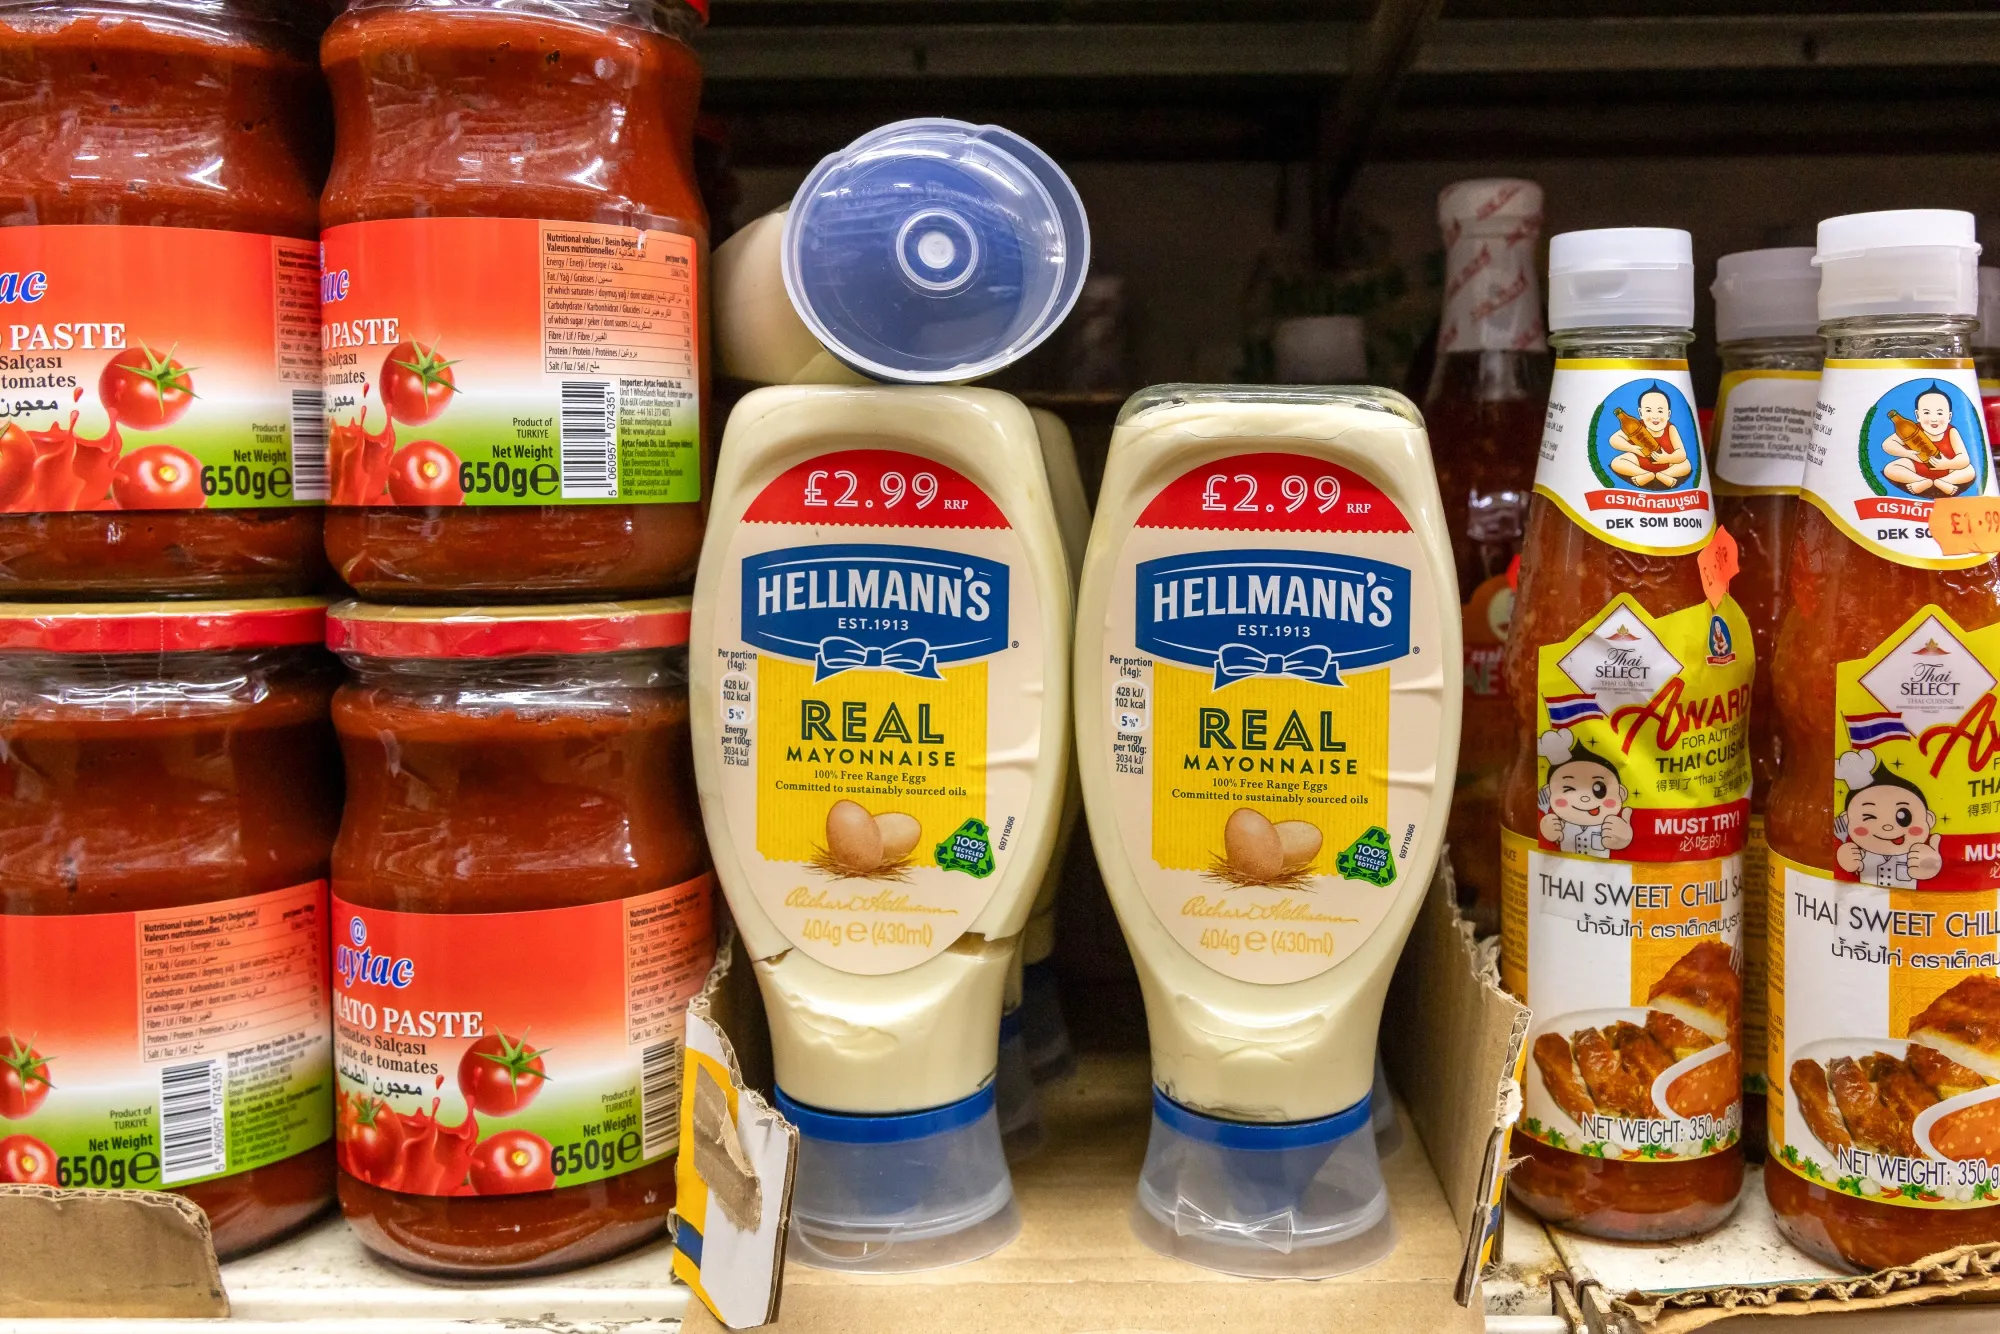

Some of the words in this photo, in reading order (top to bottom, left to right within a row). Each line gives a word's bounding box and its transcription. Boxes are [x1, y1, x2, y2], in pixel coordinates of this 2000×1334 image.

[547, 233, 580, 243] Nutritional
[582, 236, 600, 245] values
[547, 243, 570, 252] Valeurs
[571, 246, 614, 256] nutritionnelles
[546, 258, 564, 268] Energy
[574, 274, 594, 283] Graisses
[548, 301, 582, 312] Carbohydrate
[10, 323, 127, 350] PASTE
[332, 318, 400, 349] PASTE
[548, 331, 561, 340] Fibre
[578, 332, 590, 341] Fibre
[548, 346, 568, 355] Protein
[573, 346, 590, 356] Protein
[0, 355, 62, 372] Salçası
[549, 361, 560, 370] Salt
[2, 373, 76, 389] tomates
[329, 370, 366, 384] tomates
[607, 392, 616, 430] 074351
[252, 424, 278, 432] Product
[279, 424, 286, 432] of
[512, 418, 542, 427] Product
[544, 418, 552, 427] of
[234, 450, 252, 462] Net
[253, 450, 287, 465] Weight
[492, 445, 511, 458] Net
[514, 445, 554, 461] Weight
[608, 441, 616, 480] 060957
[804, 470, 938, 510] £2.99
[944, 500, 968, 510] RRP
[1202, 474, 1341, 514] £2.99
[1346, 503, 1372, 514] RRP
[1604, 492, 1700, 511] ตราเด็กสมบูรณ์
[1606, 518, 1634, 530] DEK
[1640, 517, 1668, 528] SOM
[1674, 516, 1702, 529] BOON
[1878, 528, 1908, 540] DEK
[1915, 528, 1933, 538] SO
[757, 566, 992, 622] HELLMANN'S
[1153, 572, 1394, 628] HELLMANN'S
[838, 618, 909, 631] EST.1913
[1238, 624, 1311, 638] EST.1913
[718, 648, 730, 658] Per
[730, 650, 758, 660] portion
[1110, 654, 1122, 664] Per
[1124, 657, 1152, 668] portion
[1604, 648, 1643, 666] Thai
[727, 660, 747, 671] (14g):
[1120, 666, 1142, 678] (14g):
[1595, 666, 1650, 680] SELECT
[1910, 663, 1952, 682] Thai
[724, 680, 736, 690] 428
[1116, 686, 1130, 696] 428
[1132, 688, 1144, 698] kJ/
[1900, 682, 1960, 696] SELECT
[722, 691, 735, 700] 102
[736, 692, 751, 702] kcal
[1115, 698, 1128, 708] 102
[1130, 698, 1146, 710] kcal
[801, 700, 944, 744] REAL
[1610, 677, 1750, 756] AWARD
[724, 724, 748, 737] Energy
[1200, 707, 1346, 752] REAL
[722, 736, 732, 745] per
[734, 736, 752, 748] 100g:
[1118, 732, 1142, 744] Energy
[1682, 734, 1706, 750] FOR
[724, 746, 738, 756] 3034
[786, 746, 956, 767] MAYONNAISE
[1114, 744, 1126, 753] per
[1127, 744, 1147, 756] 100g:
[724, 756, 735, 765] 725
[736, 757, 750, 766] kcal
[1116, 754, 1132, 763] 3034
[1184, 754, 1358, 774] MAYONNAISE
[1656, 753, 1700, 774] THAI
[1116, 763, 1128, 772] 725
[1130, 764, 1144, 774] kcal
[814, 770, 838, 780] 100%
[840, 770, 864, 781] Free
[866, 772, 899, 784] Range
[901, 772, 926, 786] Eggs
[1212, 778, 1238, 788] 100%
[1240, 778, 1264, 789] Free
[1267, 780, 1300, 792] Range
[1302, 781, 1328, 794] Eggs
[1656, 778, 1692, 792] 得到了
[775, 780, 831, 792] Committed
[833, 784, 844, 793] to
[846, 784, 904, 798] sustainably
[906, 786, 946, 796] sourced
[948, 786, 967, 796] oils
[1172, 788, 1230, 800] Committed
[1232, 792, 1244, 801] to
[1246, 792, 1304, 806] sustainably
[1307, 794, 1348, 804] sourced
[1350, 794, 1368, 804] oils
[1654, 817, 1708, 834] MUST
[1712, 810, 1740, 832] TRY!
[998, 815, 1016, 851] 69719366
[1398, 823, 1416, 859] 69719366
[952, 846, 984, 858] RECYCLED
[956, 836, 987, 852] 100%
[1358, 844, 1388, 860] 100%
[956, 852, 978, 862] BOTTLE
[1354, 854, 1386, 867] RECYCLED
[1357, 861, 1380, 872] BOTTLE
[1539, 873, 1584, 902] THAI
[1594, 882, 1672, 908] SWEET
[1681, 879, 1728, 906] CHILLI
[1794, 892, 1838, 926] THAI
[1850, 906, 1936, 936] SWEET
[1945, 912, 2000, 938] CHILL
[802, 918, 842, 947] 404g
[872, 922, 933, 948] (430ml)
[1577, 913, 1642, 938] น้ำจิ้มไก่
[1200, 928, 1240, 956] 404g
[1271, 930, 1334, 957] (430ml)
[1832, 936, 1900, 966] น้ำจิ้มไก่
[337, 944, 414, 988] aytac
[383, 1007, 484, 1038] PASTE
[374, 1036, 426, 1056] Salçası
[360, 1050, 372, 1066] de
[377, 1054, 438, 1074] tomates
[602, 1090, 628, 1103] Product
[110, 1110, 142, 1118] Product
[144, 1106, 152, 1116] of
[584, 1124, 600, 1138] Net
[603, 1114, 636, 1132] Weight
[1584, 1114, 1614, 1140] NET
[1620, 1119, 1684, 1144] WEIGHT:
[1690, 1114, 1712, 1141] 350
[89, 1138, 108, 1152] Net
[111, 1134, 153, 1150] Weight
[1838, 1147, 1870, 1176] NET
[1878, 1155, 1950, 1186] WEIGHT:
[1958, 1160, 1986, 1186] 350
